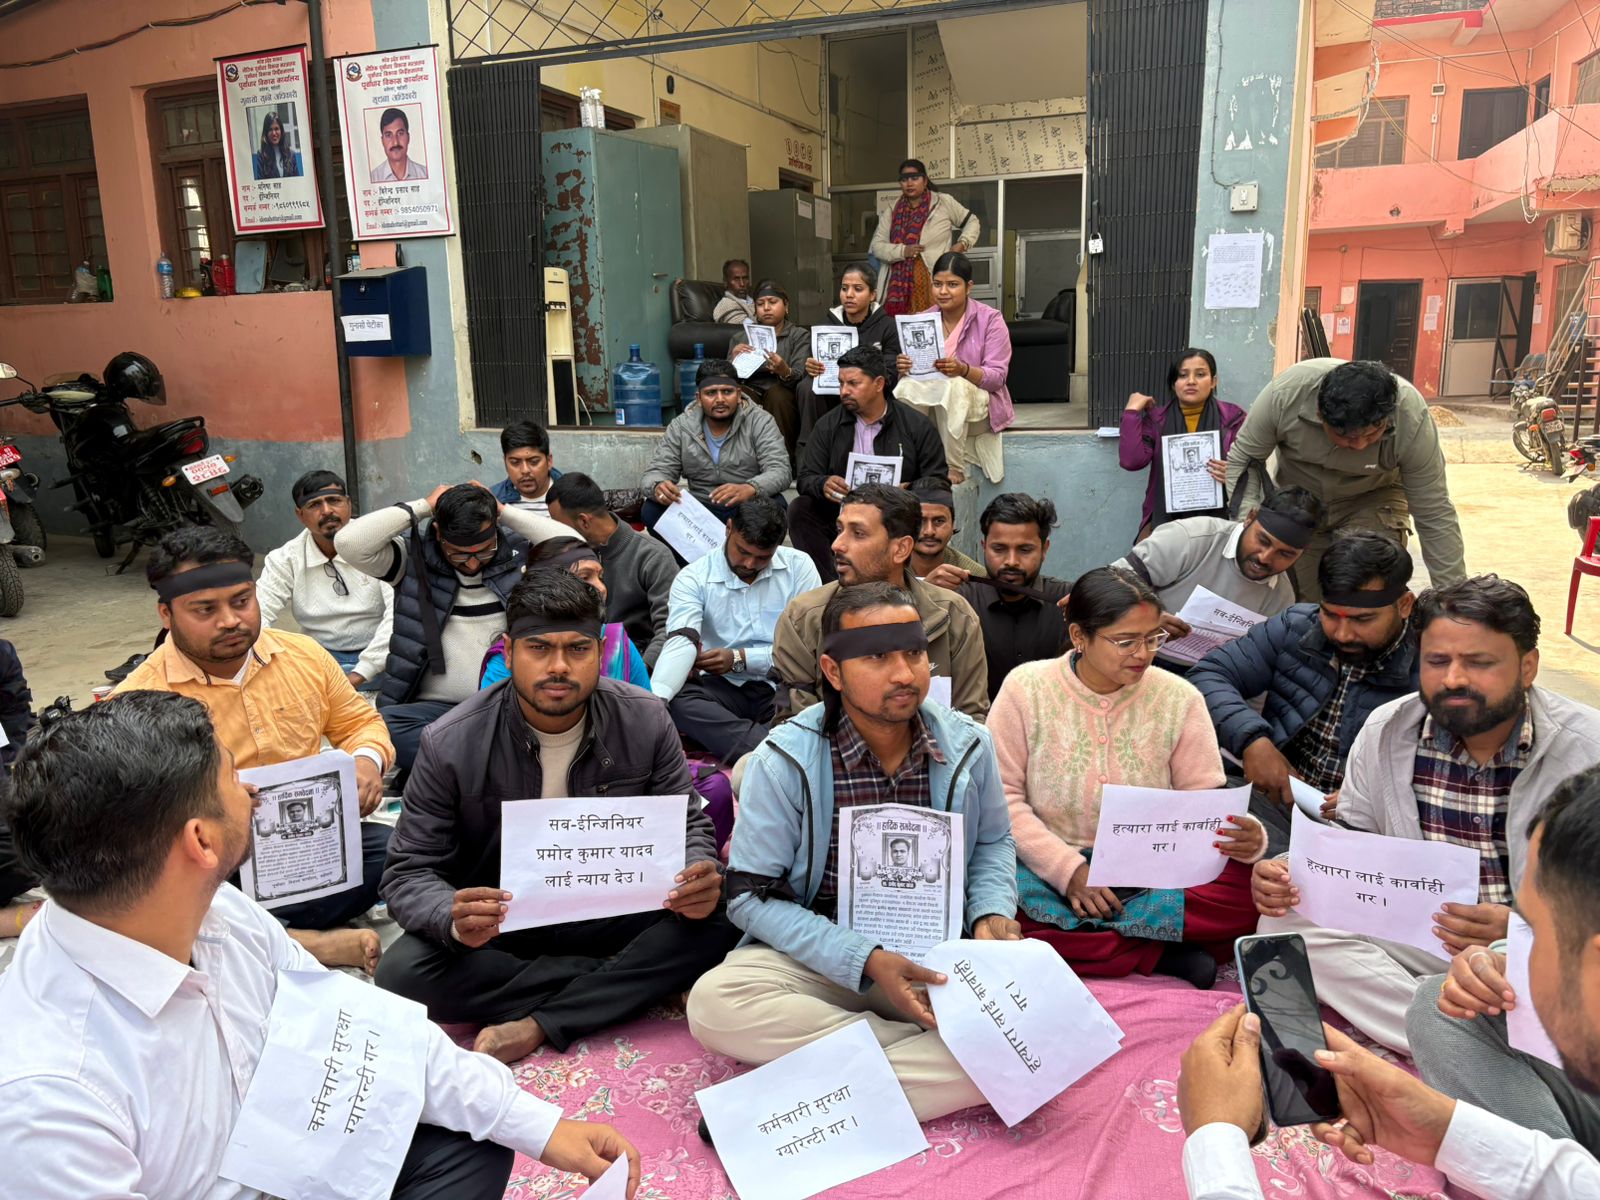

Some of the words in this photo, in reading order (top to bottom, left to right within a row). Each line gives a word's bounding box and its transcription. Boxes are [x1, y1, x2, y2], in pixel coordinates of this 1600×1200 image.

[400, 205, 438, 214] 9854050971
[549, 813, 645, 833] सब-ईन्जिनियर
[881, 819, 899, 831] हार्दिक
[1112, 823, 1153, 836] हत्यारा
[1155, 820, 1179, 834] लाई
[1182, 817, 1223, 834] कार्वाही
[536, 844, 574, 861] प्रमोद
[577, 846, 616, 864] कुमार
[620, 843, 655, 858] यादव
[1152, 842, 1169, 854] गर
[545, 871, 574, 888] लाई
[577, 872, 611, 886] न्याय
[614, 868, 635, 886] देउ
[1306, 857, 1351, 880] हत्यारा
[1355, 871, 1385, 888] लाई
[1389, 877, 1446, 896] कार्वाही
[1355, 892, 1377, 905] गर
[953, 959, 987, 1001] कार्वाही
[1009, 988, 1029, 1012] गर
[980, 997, 1006, 1029] लाई
[1002, 1027, 1043, 1074] हत्यारा
[307, 1056, 344, 1132] कर्मचारी
[331, 1008, 353, 1054] सुरक्षा
[343, 1064, 377, 1135] ग्यारेन्टी
[363, 1039, 380, 1062] गर
[757, 1101, 812, 1136] कर्मचारी
[813, 1084, 852, 1115] सुरक्षा
[775, 1127, 827, 1158] ग्यारेन्टी
[827, 1117, 853, 1136] गर
